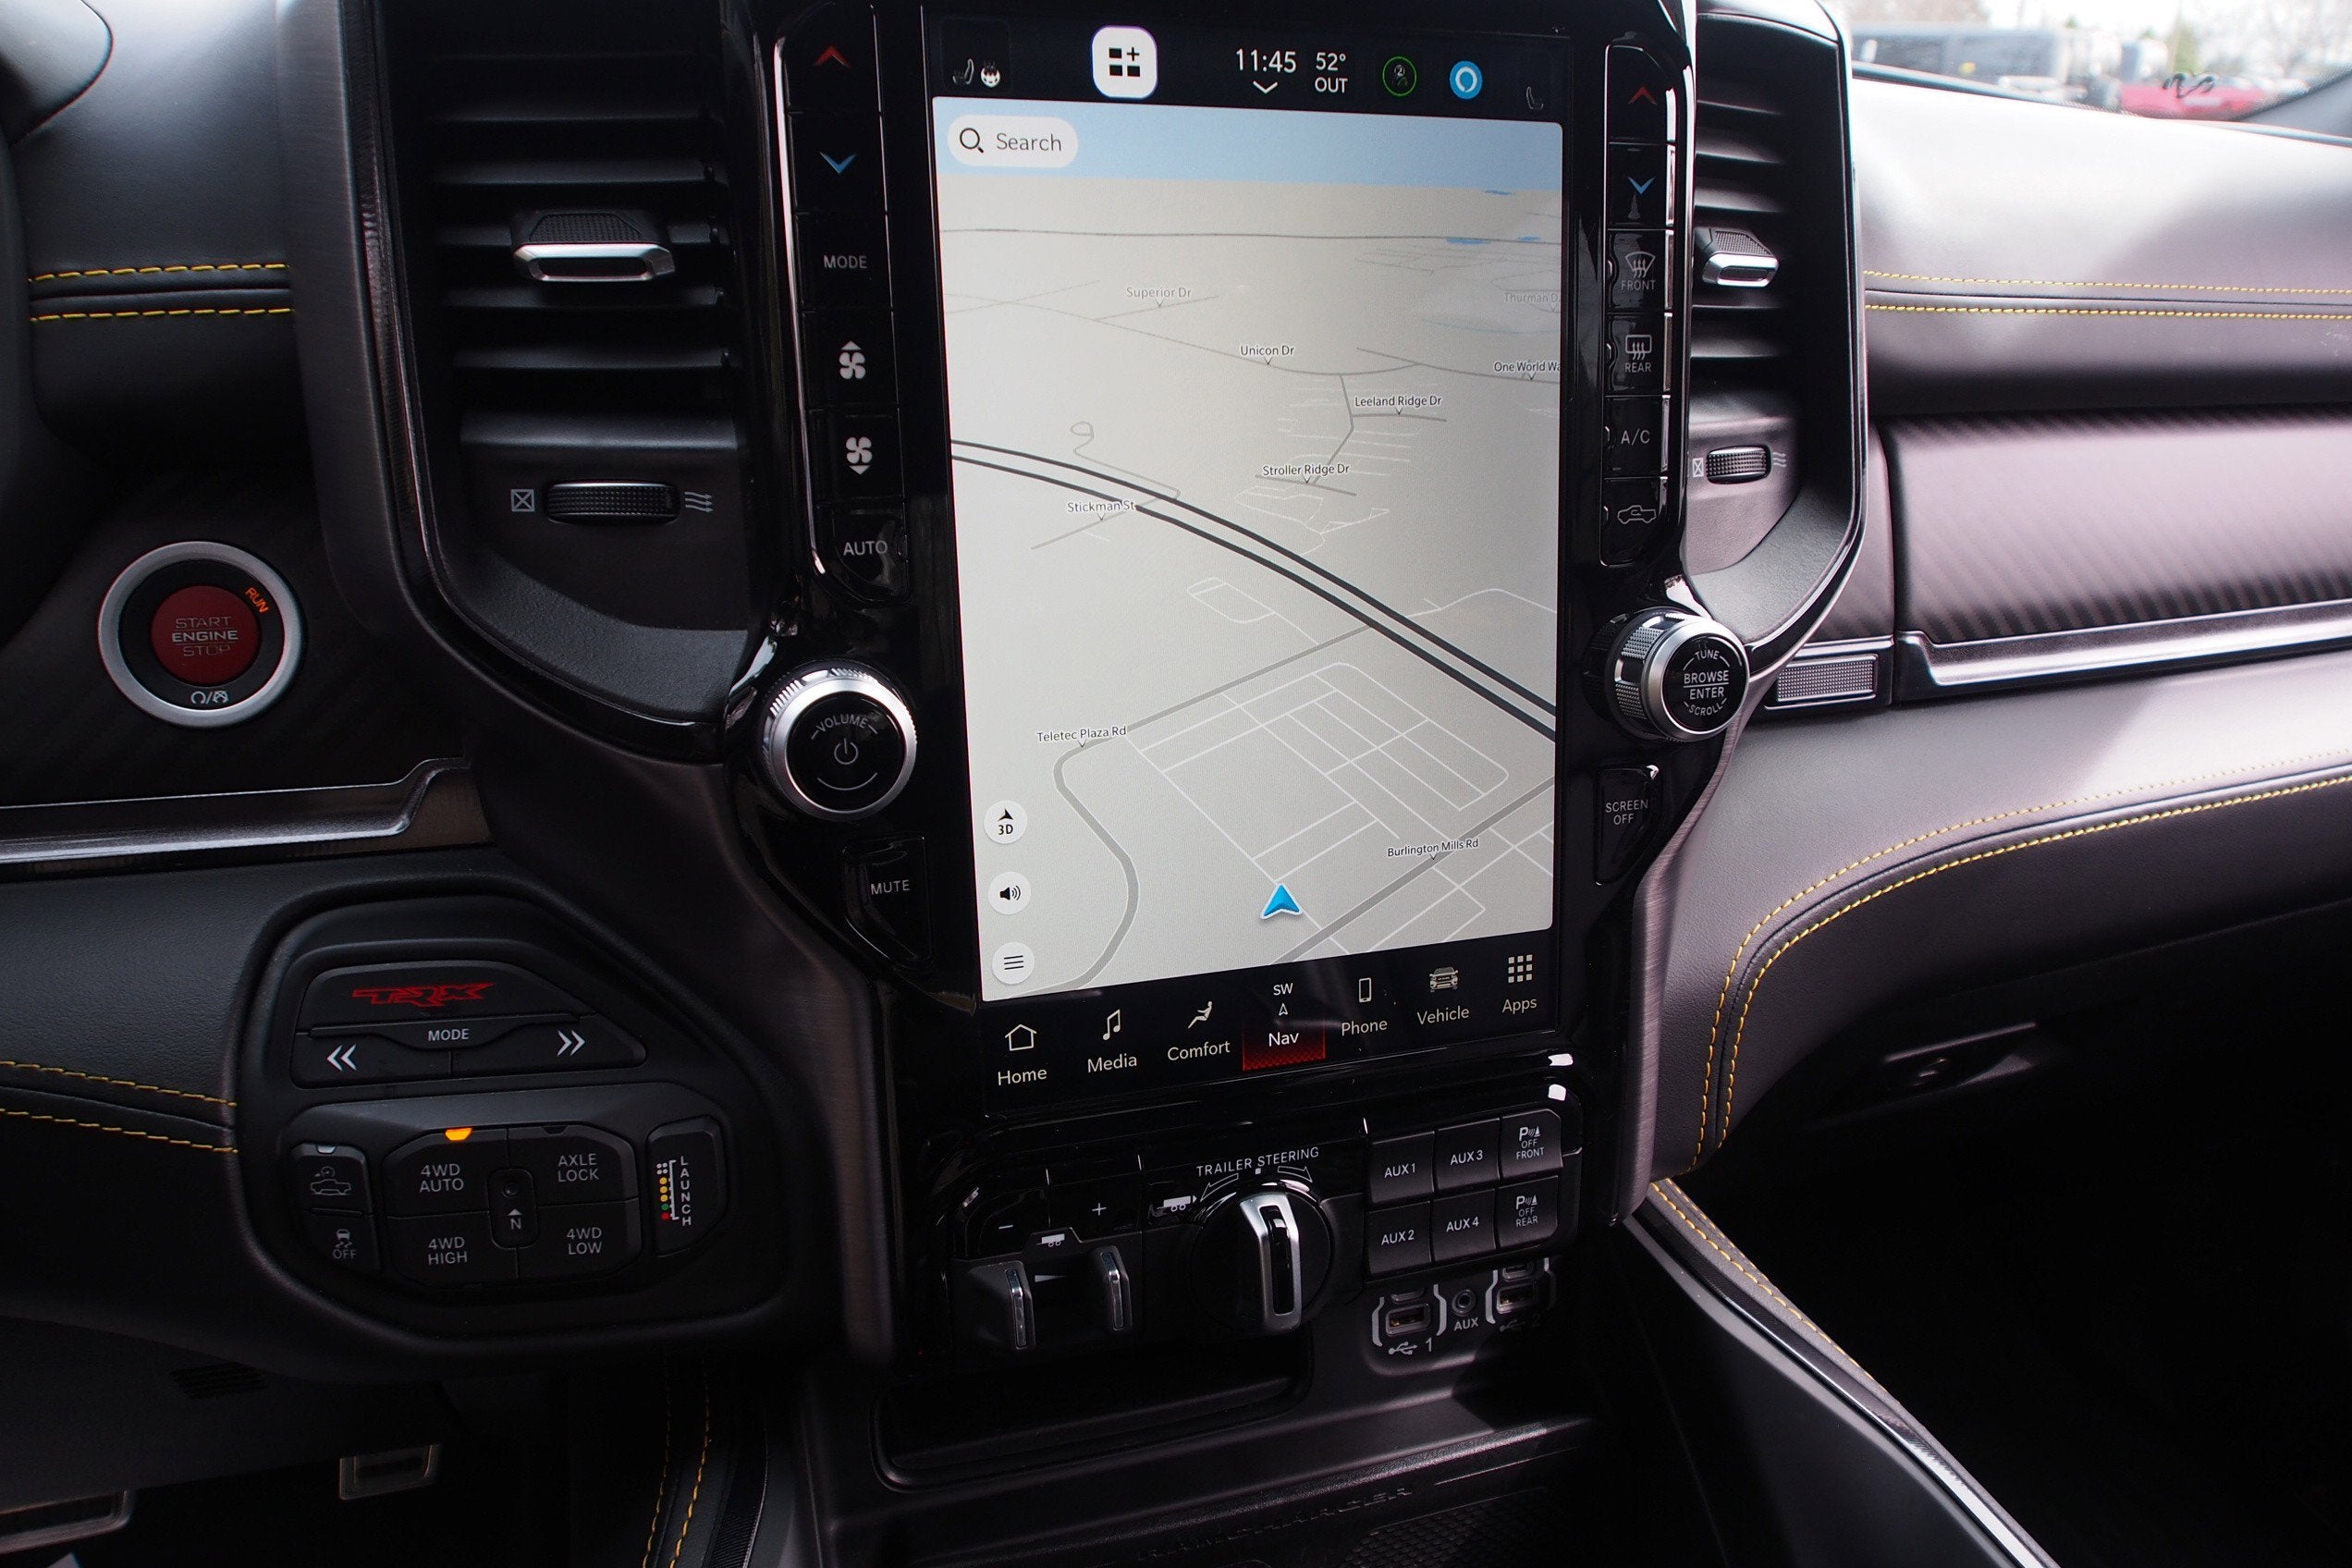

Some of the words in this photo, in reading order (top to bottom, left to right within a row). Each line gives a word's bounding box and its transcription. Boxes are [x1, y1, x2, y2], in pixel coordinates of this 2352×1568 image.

[1235, 48, 1296, 73] 11:45
[1315, 52, 1346, 71] 52°
[1314, 76, 1348, 93] OUT
[996, 132, 1061, 152] Search
[823, 254, 867, 269] MODE
[1621, 279, 1655, 291] FRONT
[1126, 287, 1175, 300] Superior
[1179, 287, 1191, 298] Dr
[1504, 292, 1549, 303] Thurman
[1551, 293, 1561, 303] D
[1240, 345, 1278, 357] Unicon
[1281, 345, 1294, 356] Dr
[1494, 361, 1514, 372] One
[1517, 361, 1545, 372] World
[1624, 361, 1652, 374] REAR
[1354, 396, 1395, 407] Leeland
[1398, 396, 1427, 409] Ridge
[1429, 396, 1441, 407] Dr
[1621, 430, 1650, 446] A/C
[1263, 465, 1302, 476] Stroller
[1305, 465, 1334, 477] Ridge
[1337, 463, 1350, 474] Dr
[1067, 501, 1121, 514] Stickman
[1122, 500, 1135, 512] St
[843, 539, 888, 556] AUTO
[245, 587, 269, 613] RUN
[175, 616, 231, 629] START
[172, 630, 239, 643] ENGINE
[183, 645, 230, 656] STOP
[1695, 649, 1720, 661] TUNE
[1684, 670, 1729, 684] BROWSE
[1689, 686, 1724, 700] ENTER
[1689, 701, 1723, 716] SCROLL
[817, 713, 868, 733] VOLUME
[1036, 730, 1076, 742] Teletec
[1080, 729, 1109, 740] Plaza
[1111, 726, 1126, 737] Rd
[1605, 800, 1649, 813] SCREEN
[1613, 815, 1635, 826] OFF
[998, 824, 1013, 836] 3D
[1387, 843, 1439, 858] Burlington
[1441, 840, 1464, 852] Mills
[1465, 839, 1479, 849] Rd
[870, 880, 910, 895] MUTE
[351, 982, 496, 1008] TRX
[1273, 983, 1292, 996] SW
[1502, 998, 1537, 1015] Apps
[1417, 1006, 1469, 1025] Vehicle
[428, 1028, 470, 1042] MODE
[1341, 1020, 1388, 1036] Phone
[1268, 1031, 1299, 1047] Nav
[1167, 1040, 1231, 1061] Comfort
[1087, 1054, 1137, 1073] Media
[998, 1068, 1047, 1085] Home
[1521, 1139, 1538, 1149] OFF
[557, 1152, 597, 1168] AXLE
[1196, 1156, 1253, 1177] TRAILER
[1257, 1146, 1320, 1167] STEERING
[1450, 1152, 1475, 1166] AUX
[1476, 1148, 1484, 1160] 3
[1516, 1147, 1545, 1161] FRONT
[421, 1163, 460, 1178] 4WD
[557, 1167, 599, 1183] LOCK
[1410, 1162, 1416, 1174] 1
[419, 1178, 464, 1194] AUTO
[680, 1156, 692, 1227] LAUNCH
[1517, 1205, 1536, 1218] OFF
[510, 1217, 522, 1231] N
[1445, 1217, 1470, 1232] AUX
[1472, 1217, 1480, 1228] 4
[1514, 1214, 1538, 1227] REAR
[567, 1228, 603, 1241] 4WD
[1381, 1233, 1406, 1245] AUX
[1408, 1229, 1415, 1241] 2
[428, 1237, 465, 1250] 4WD
[568, 1241, 603, 1256] LOW
[332, 1249, 357, 1260] OFF
[427, 1249, 468, 1265] HIGH
[1454, 1318, 1478, 1330] AUX
[1426, 1339, 1433, 1353] 1
